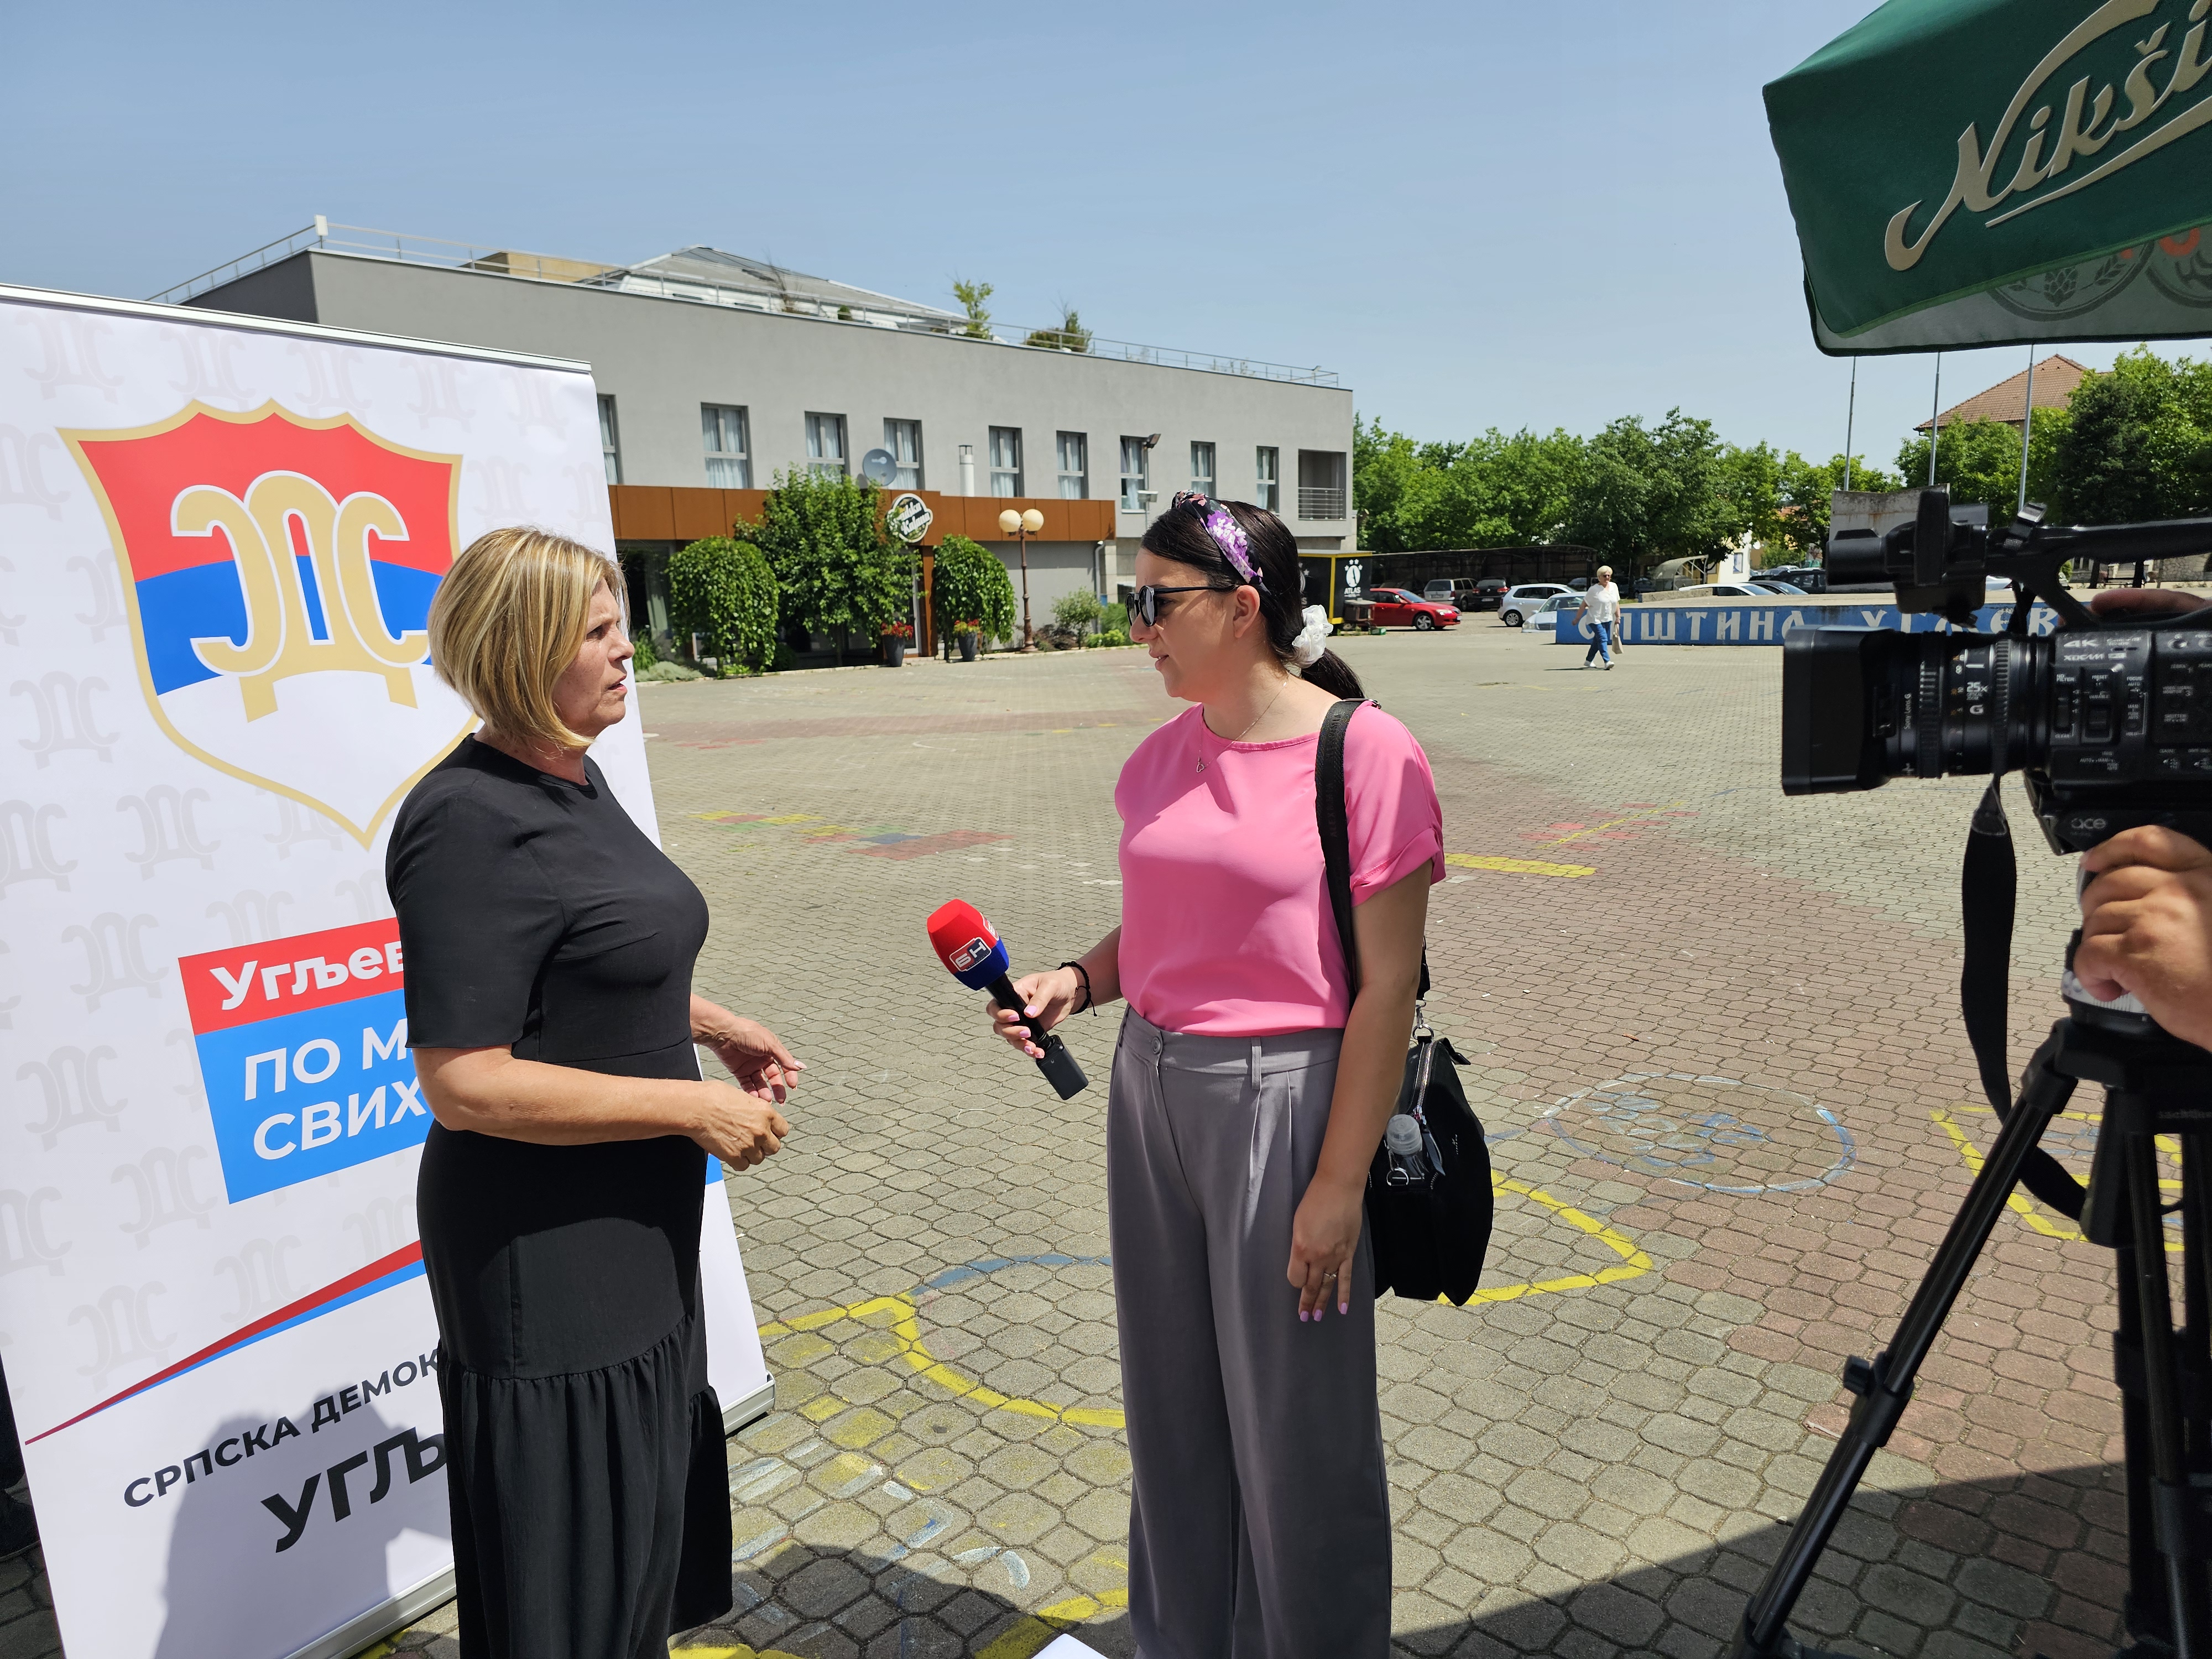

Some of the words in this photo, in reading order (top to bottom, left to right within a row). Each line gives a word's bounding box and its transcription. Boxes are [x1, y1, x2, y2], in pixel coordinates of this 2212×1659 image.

[2064, 639, 2099, 648] 4K
[244, 1038, 341, 1102] ПО
[253, 1076, 427, 1161] СВИХ
[123, 1416, 301, 1507] СРПСКА
[311, 1348, 437, 1433] ДЕМОК
